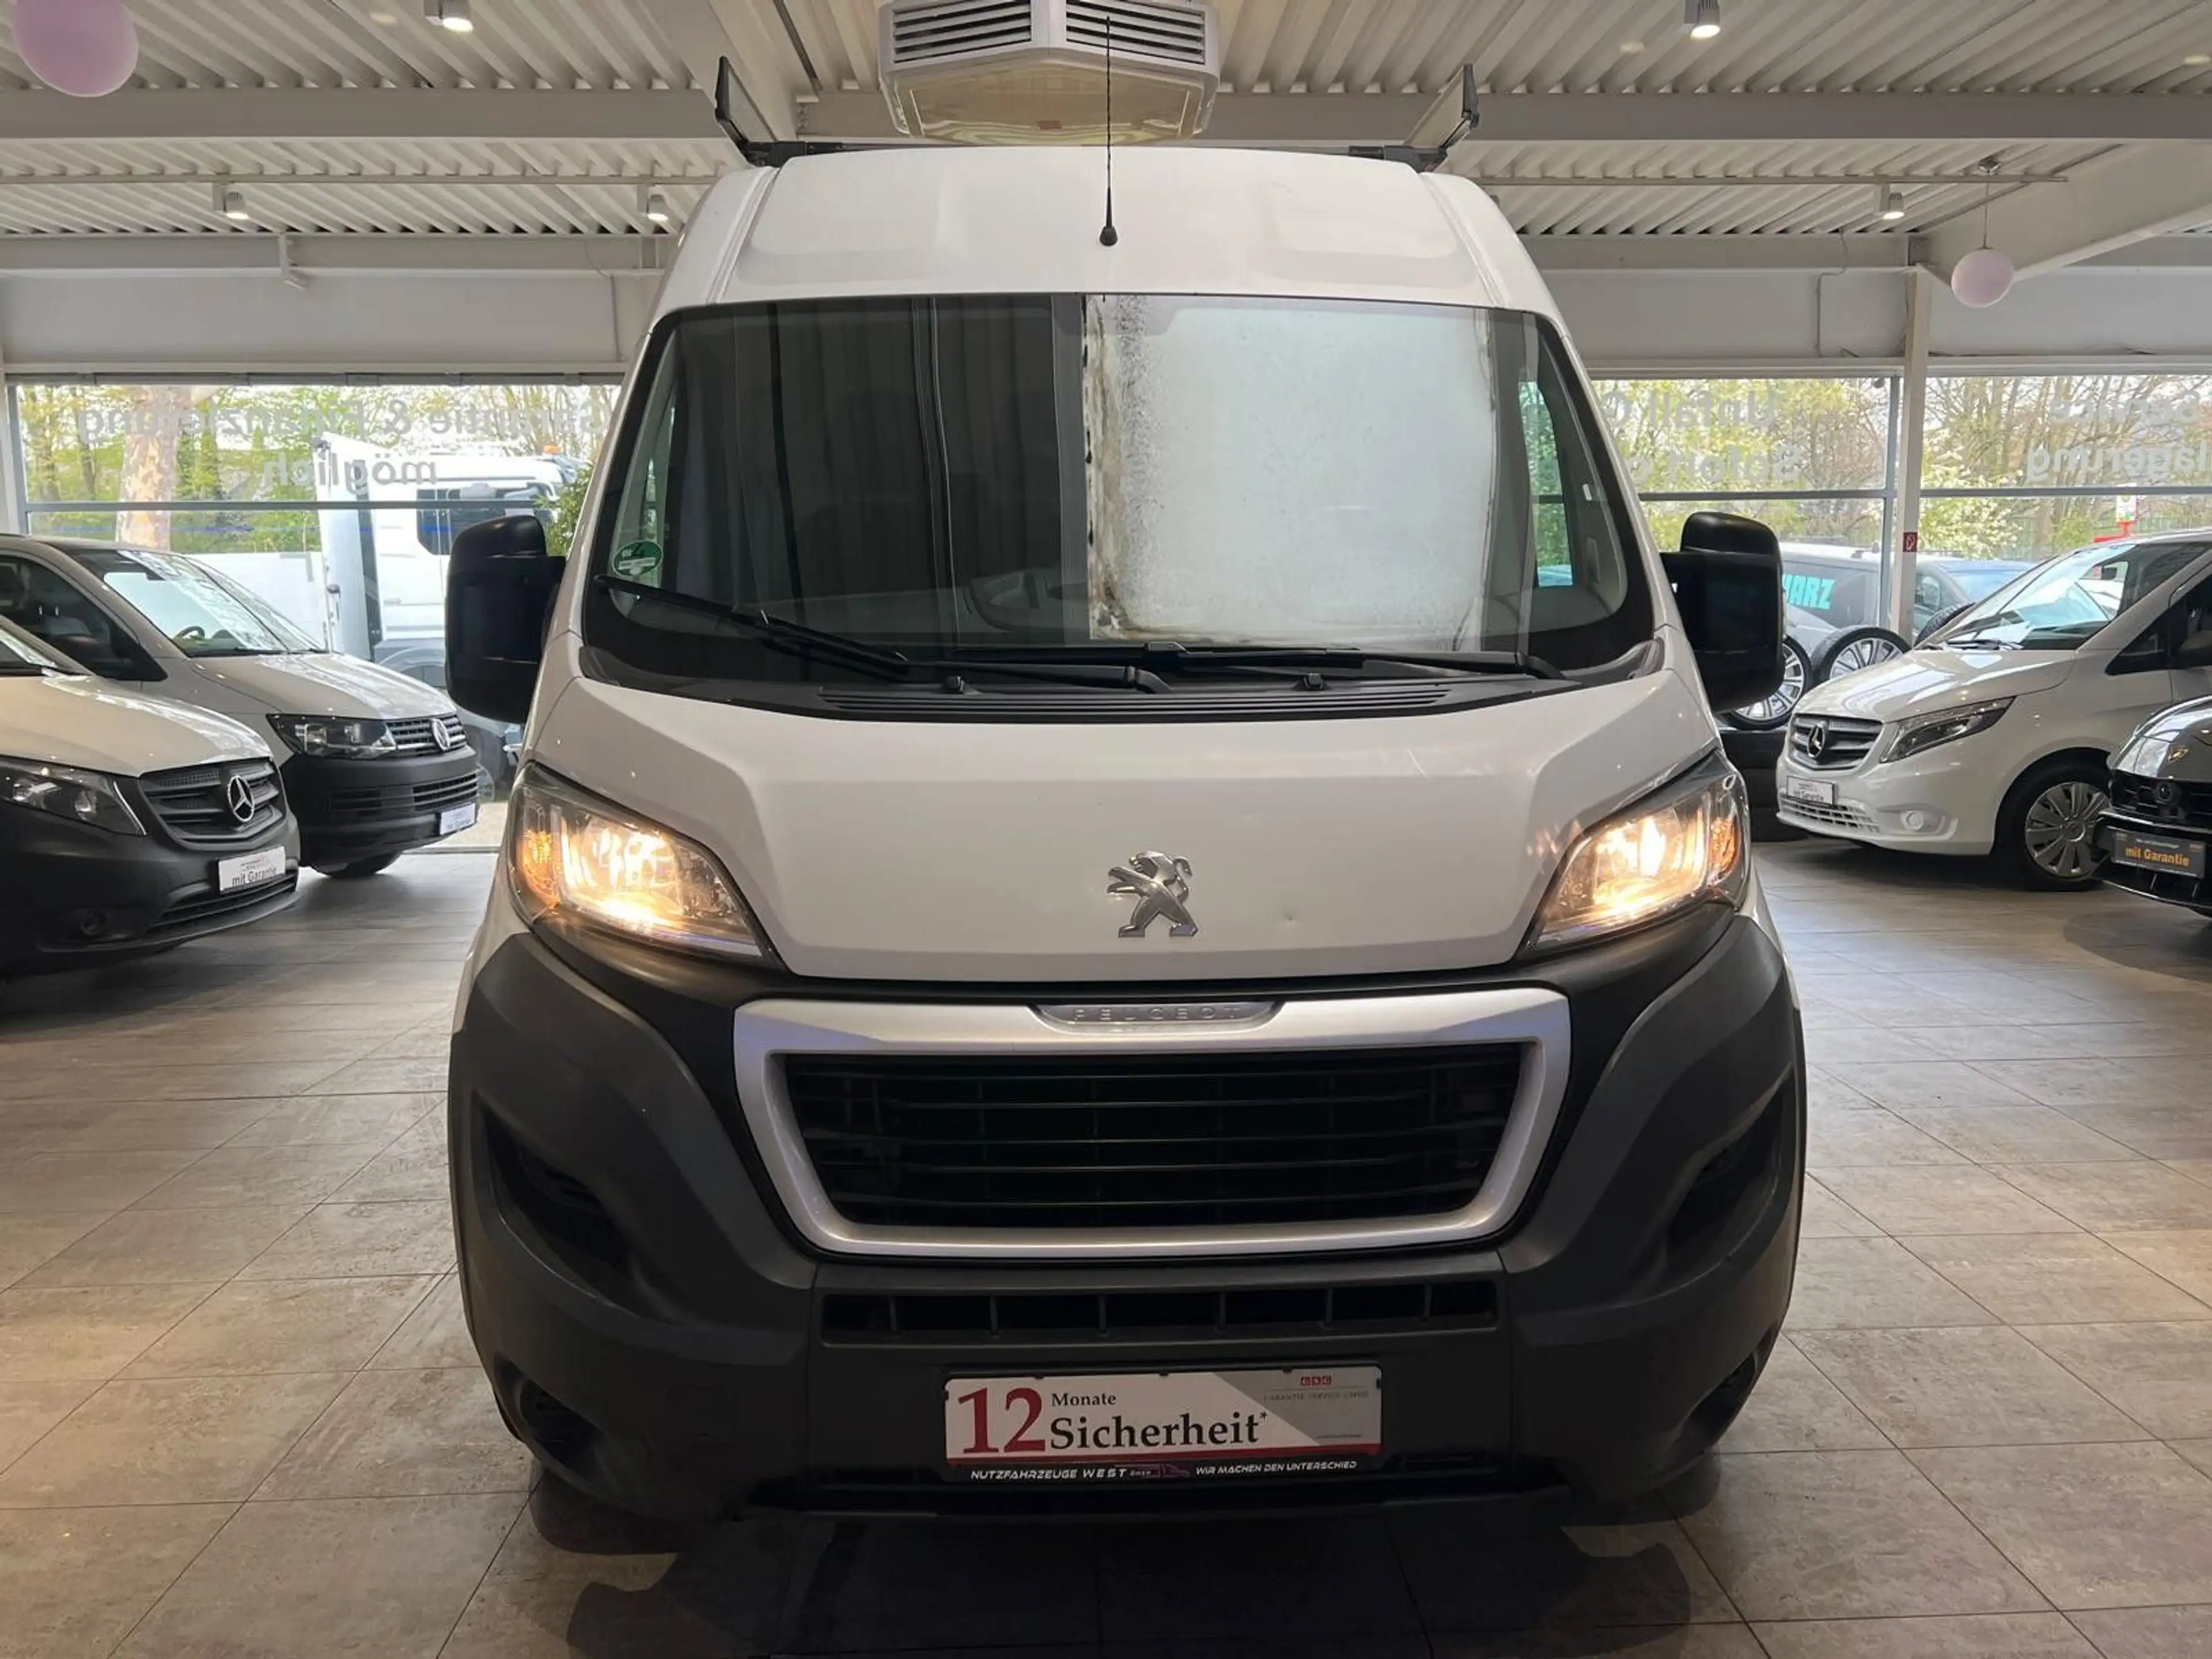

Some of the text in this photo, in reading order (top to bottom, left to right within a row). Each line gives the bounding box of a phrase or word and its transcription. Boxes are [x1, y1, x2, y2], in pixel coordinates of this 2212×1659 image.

[2125, 847, 2190, 866] mit Garantie
[1051, 1392, 1117, 1407] Monate
[958, 1385, 1047, 1455] 12
[970, 1468, 1077, 1480] NUTZFAHRZEUGE
[1082, 1468, 1127, 1479] WEST
[1196, 1460, 1358, 1475] WIR MACHEN DEN UNTERSCHIED
